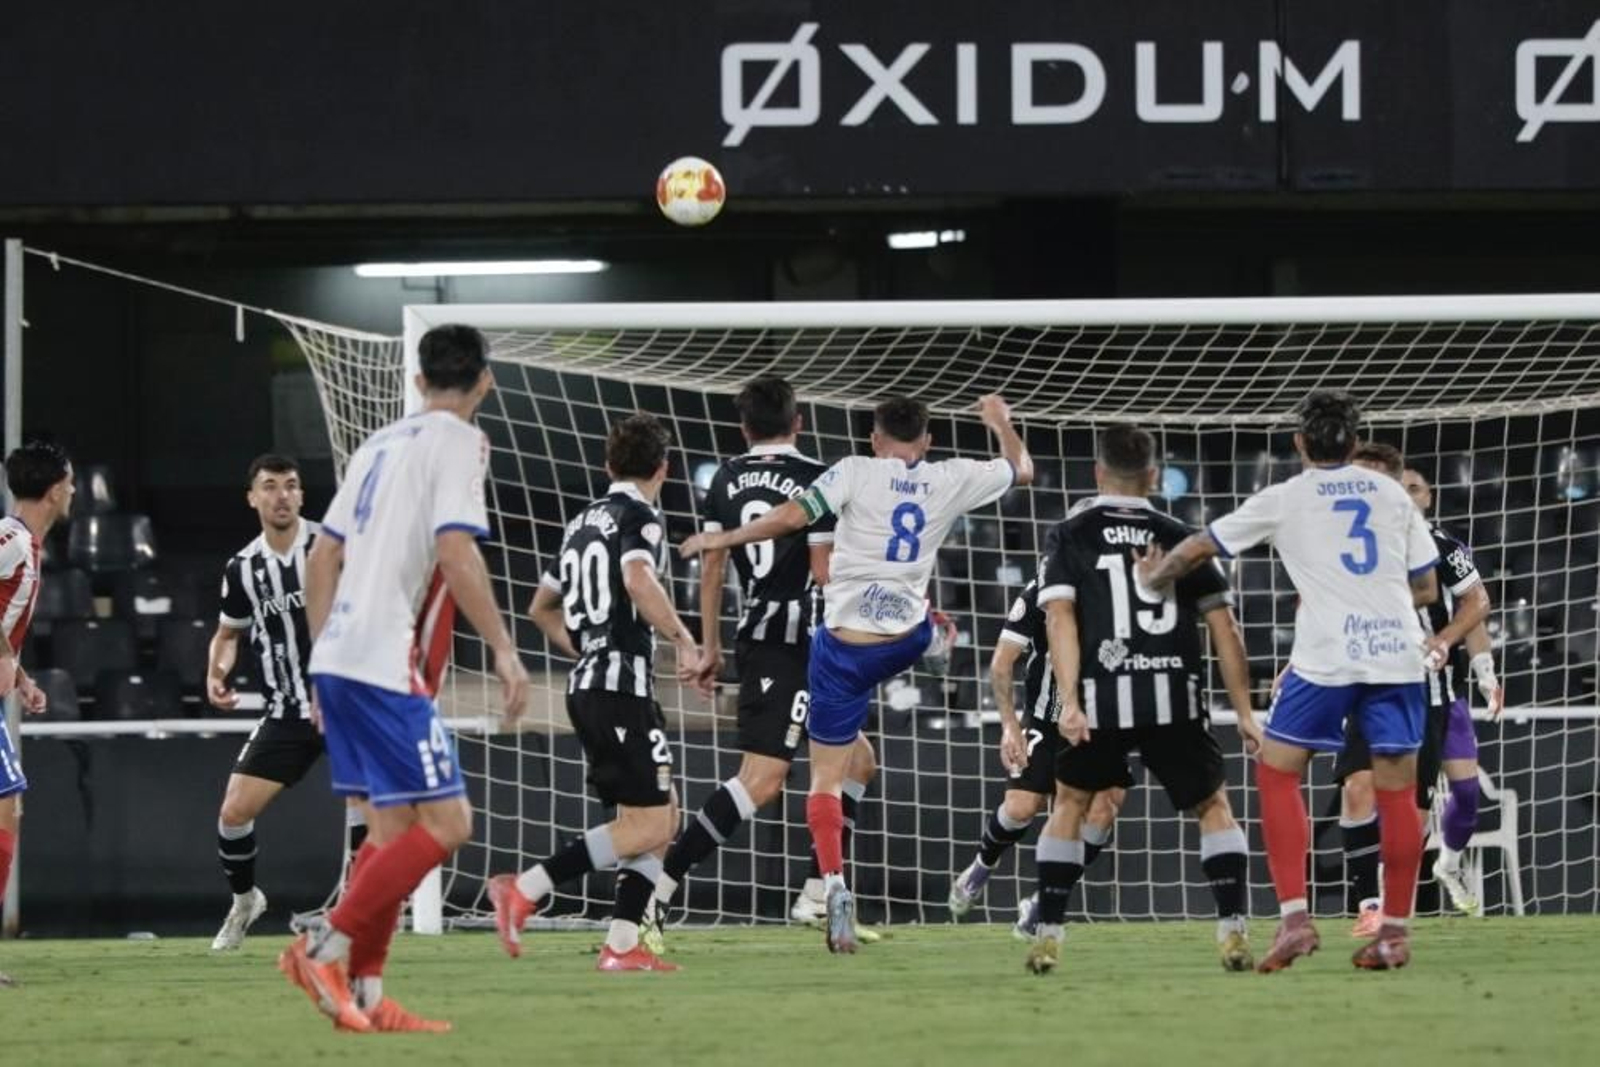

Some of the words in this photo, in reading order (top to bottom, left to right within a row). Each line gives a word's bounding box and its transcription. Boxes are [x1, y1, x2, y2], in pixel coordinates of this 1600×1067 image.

[1316, 481, 1378, 496] JOSECA
[886, 501, 925, 563] 8
[1332, 498, 1379, 576] 3
[560, 541, 611, 630] 20
[1124, 654, 1183, 671] ribera
[791, 690, 808, 723] 6
[430, 717, 450, 756] 4
[648, 728, 673, 764] 2
